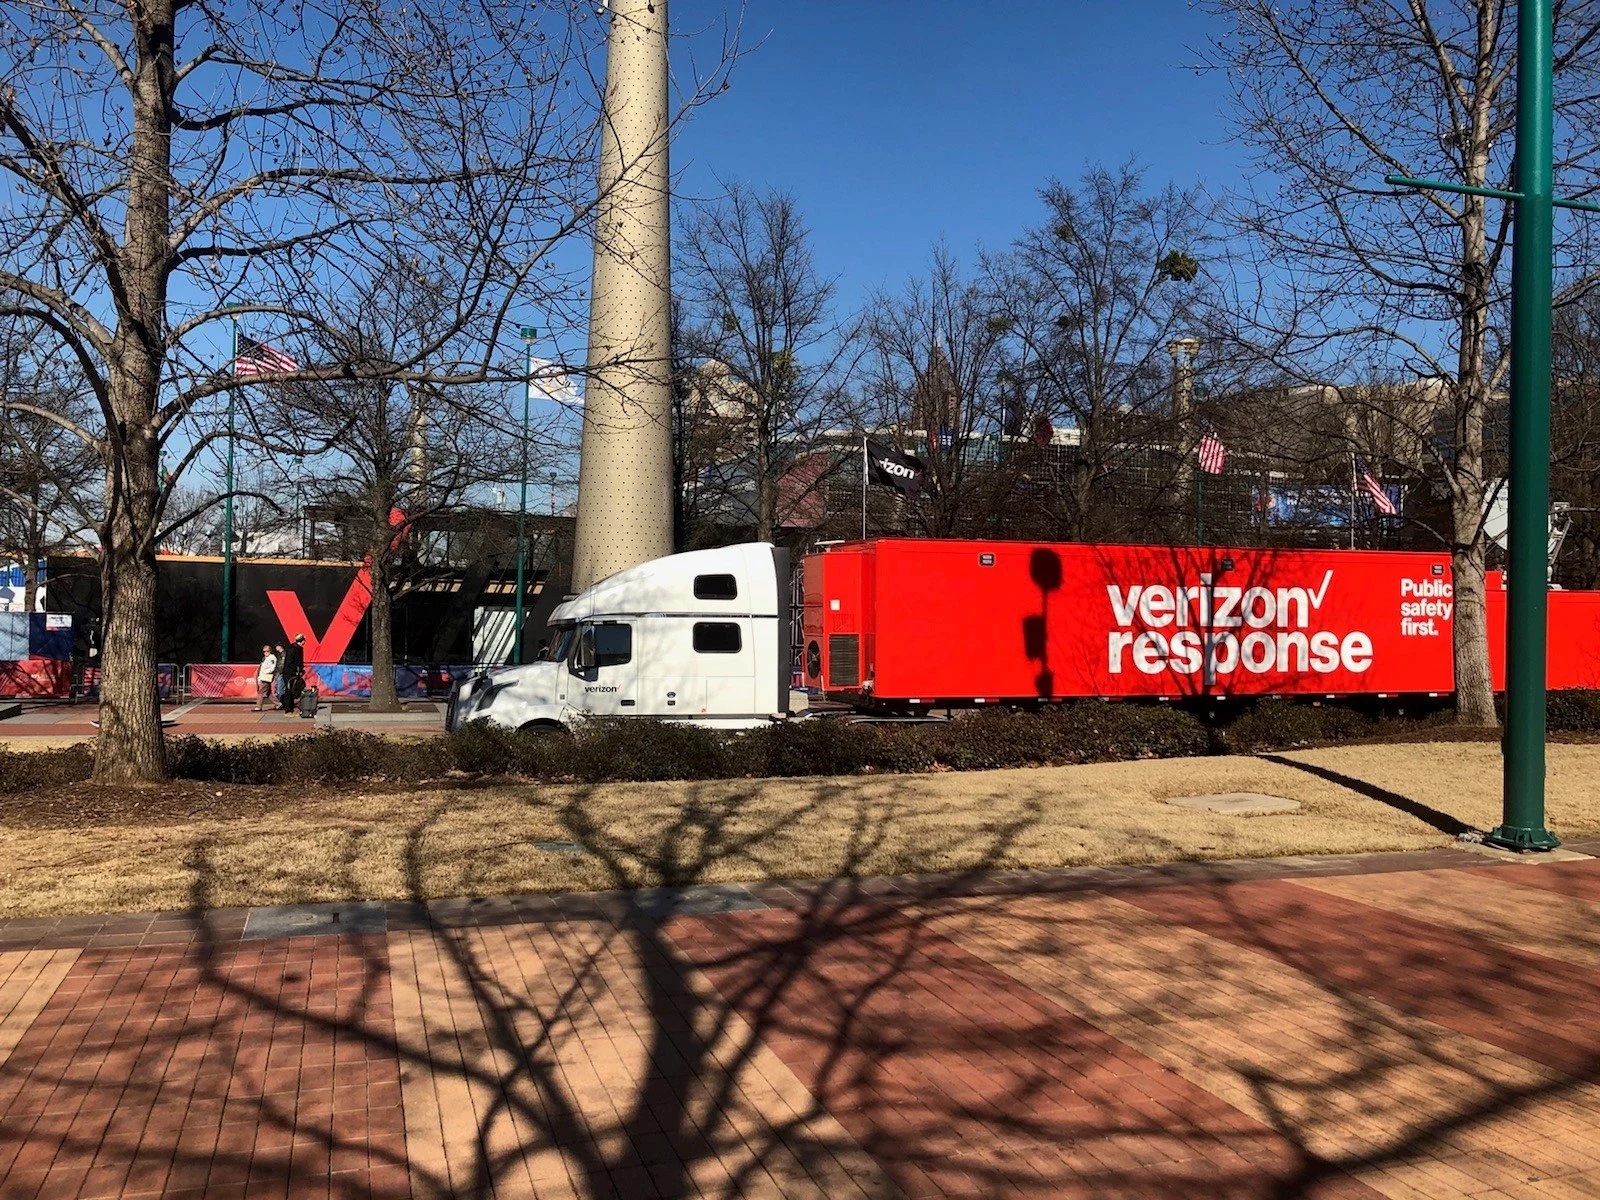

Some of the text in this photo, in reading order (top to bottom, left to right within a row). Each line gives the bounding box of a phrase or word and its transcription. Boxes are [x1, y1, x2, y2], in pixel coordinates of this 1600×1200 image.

[1400, 578, 1453, 597] Public
[1106, 572, 1309, 628] verizon
[1400, 598, 1453, 620] safety
[1400, 617, 1439, 636] first.
[1108, 631, 1374, 686] response
[584, 684, 618, 693] verizon
